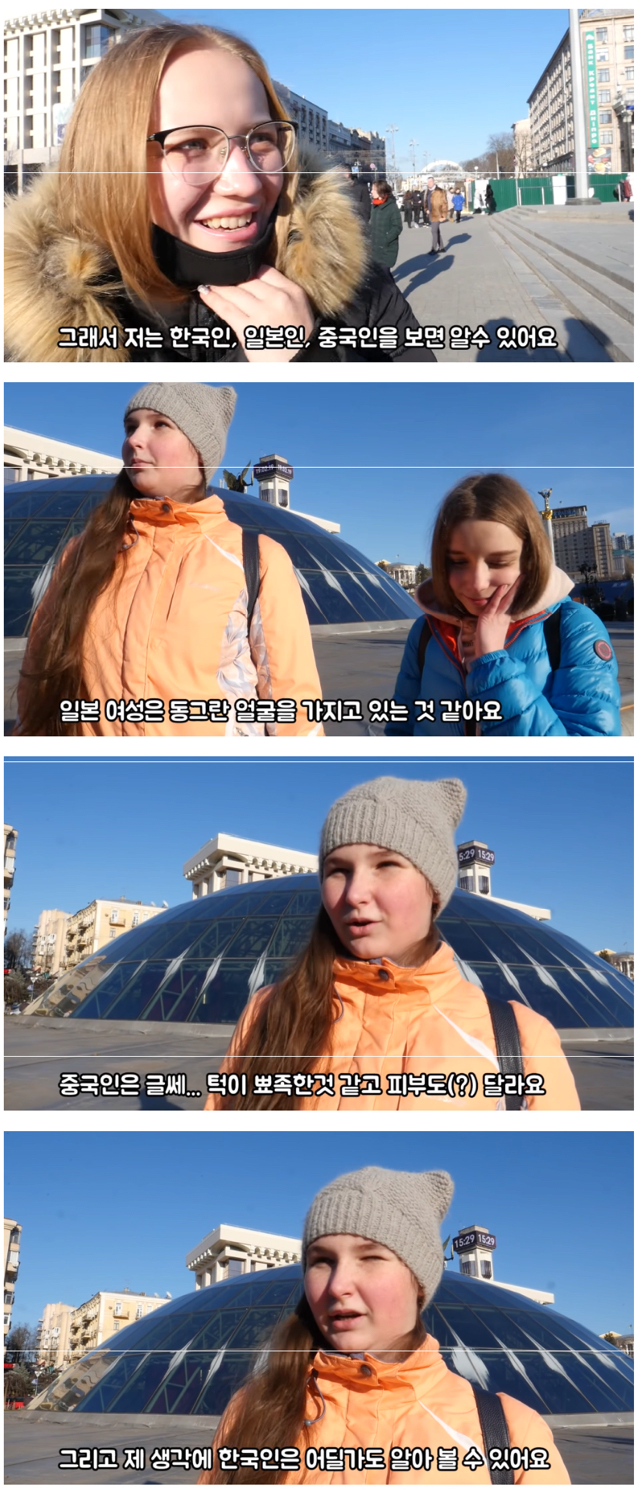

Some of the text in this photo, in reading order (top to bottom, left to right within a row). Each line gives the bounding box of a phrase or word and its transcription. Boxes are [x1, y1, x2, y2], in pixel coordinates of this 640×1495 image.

[477, 849, 495, 862] 15:29
[454, 1234, 495, 1249] 15:29 15:29
